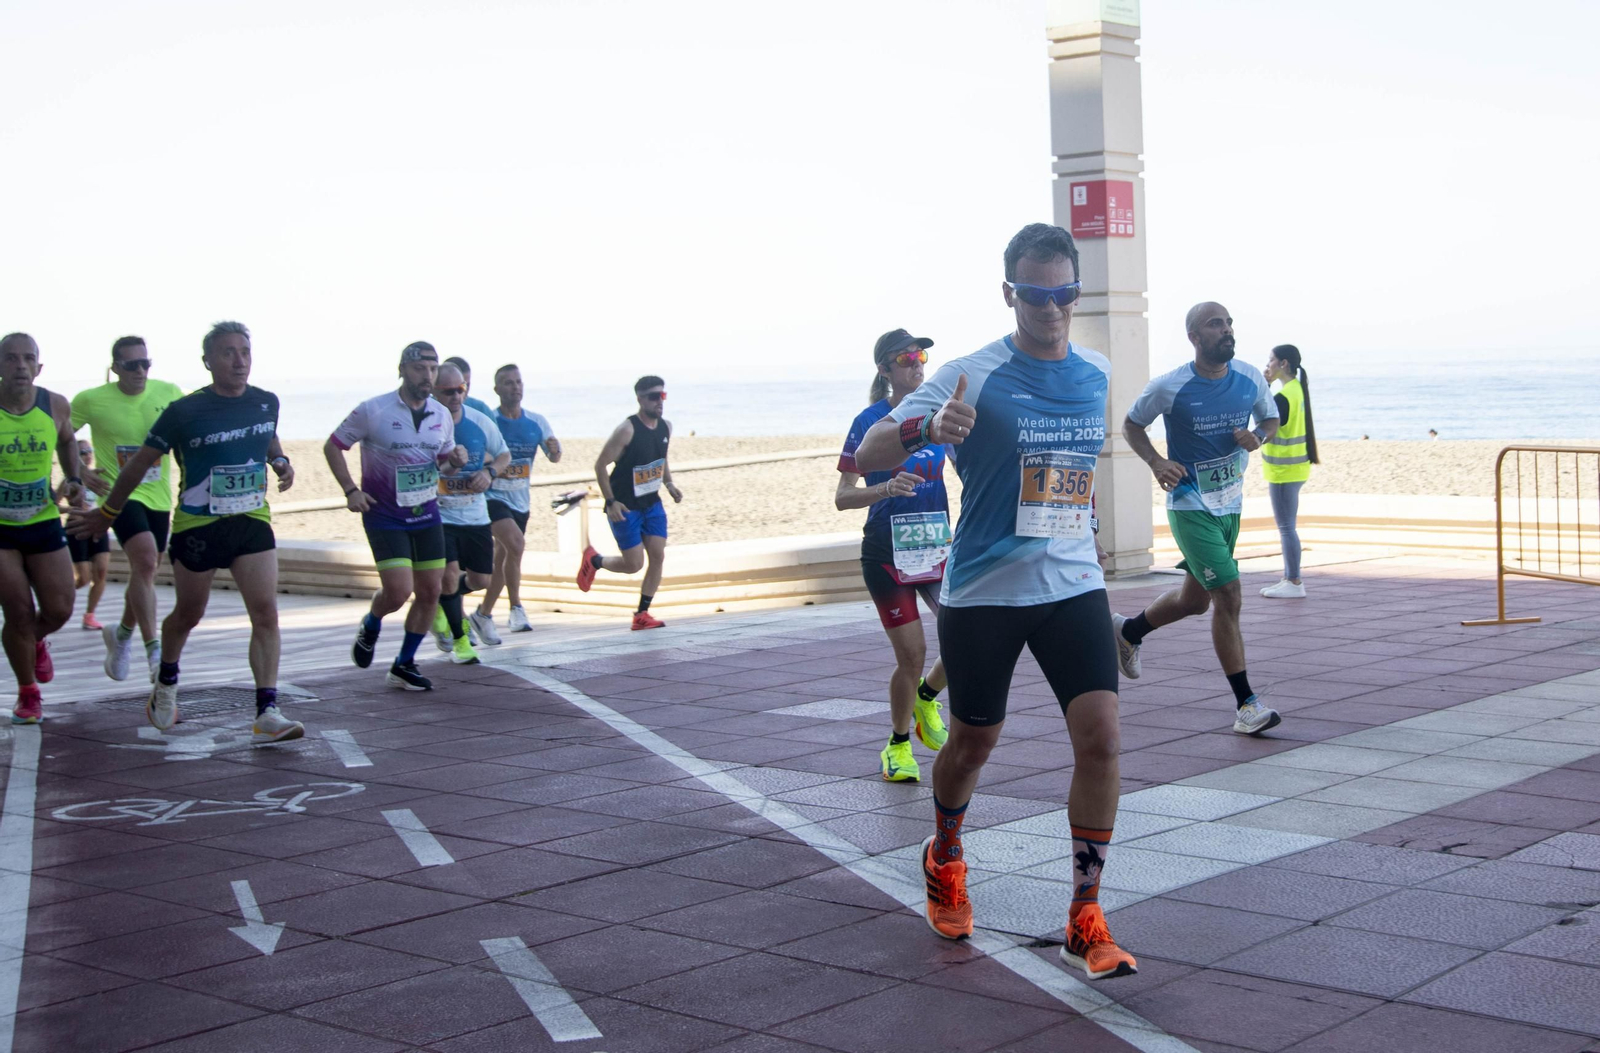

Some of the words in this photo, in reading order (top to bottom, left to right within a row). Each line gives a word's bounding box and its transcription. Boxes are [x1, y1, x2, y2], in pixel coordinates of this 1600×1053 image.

[1017, 417, 1056, 428] Medio
[1061, 415, 1104, 427] Maratón
[1193, 415, 1218, 423] Medio
[1194, 420, 1228, 431] Almería
[1018, 428, 1072, 443] Almería
[1074, 426, 1104, 441] 2025
[1016, 445, 1048, 455] RAMÓN
[225, 473, 255, 490] 311
[408, 470, 433, 485] 312
[1033, 468, 1089, 497] 1356
[2, 487, 45, 502] 1319
[899, 523, 944, 542] 2397
